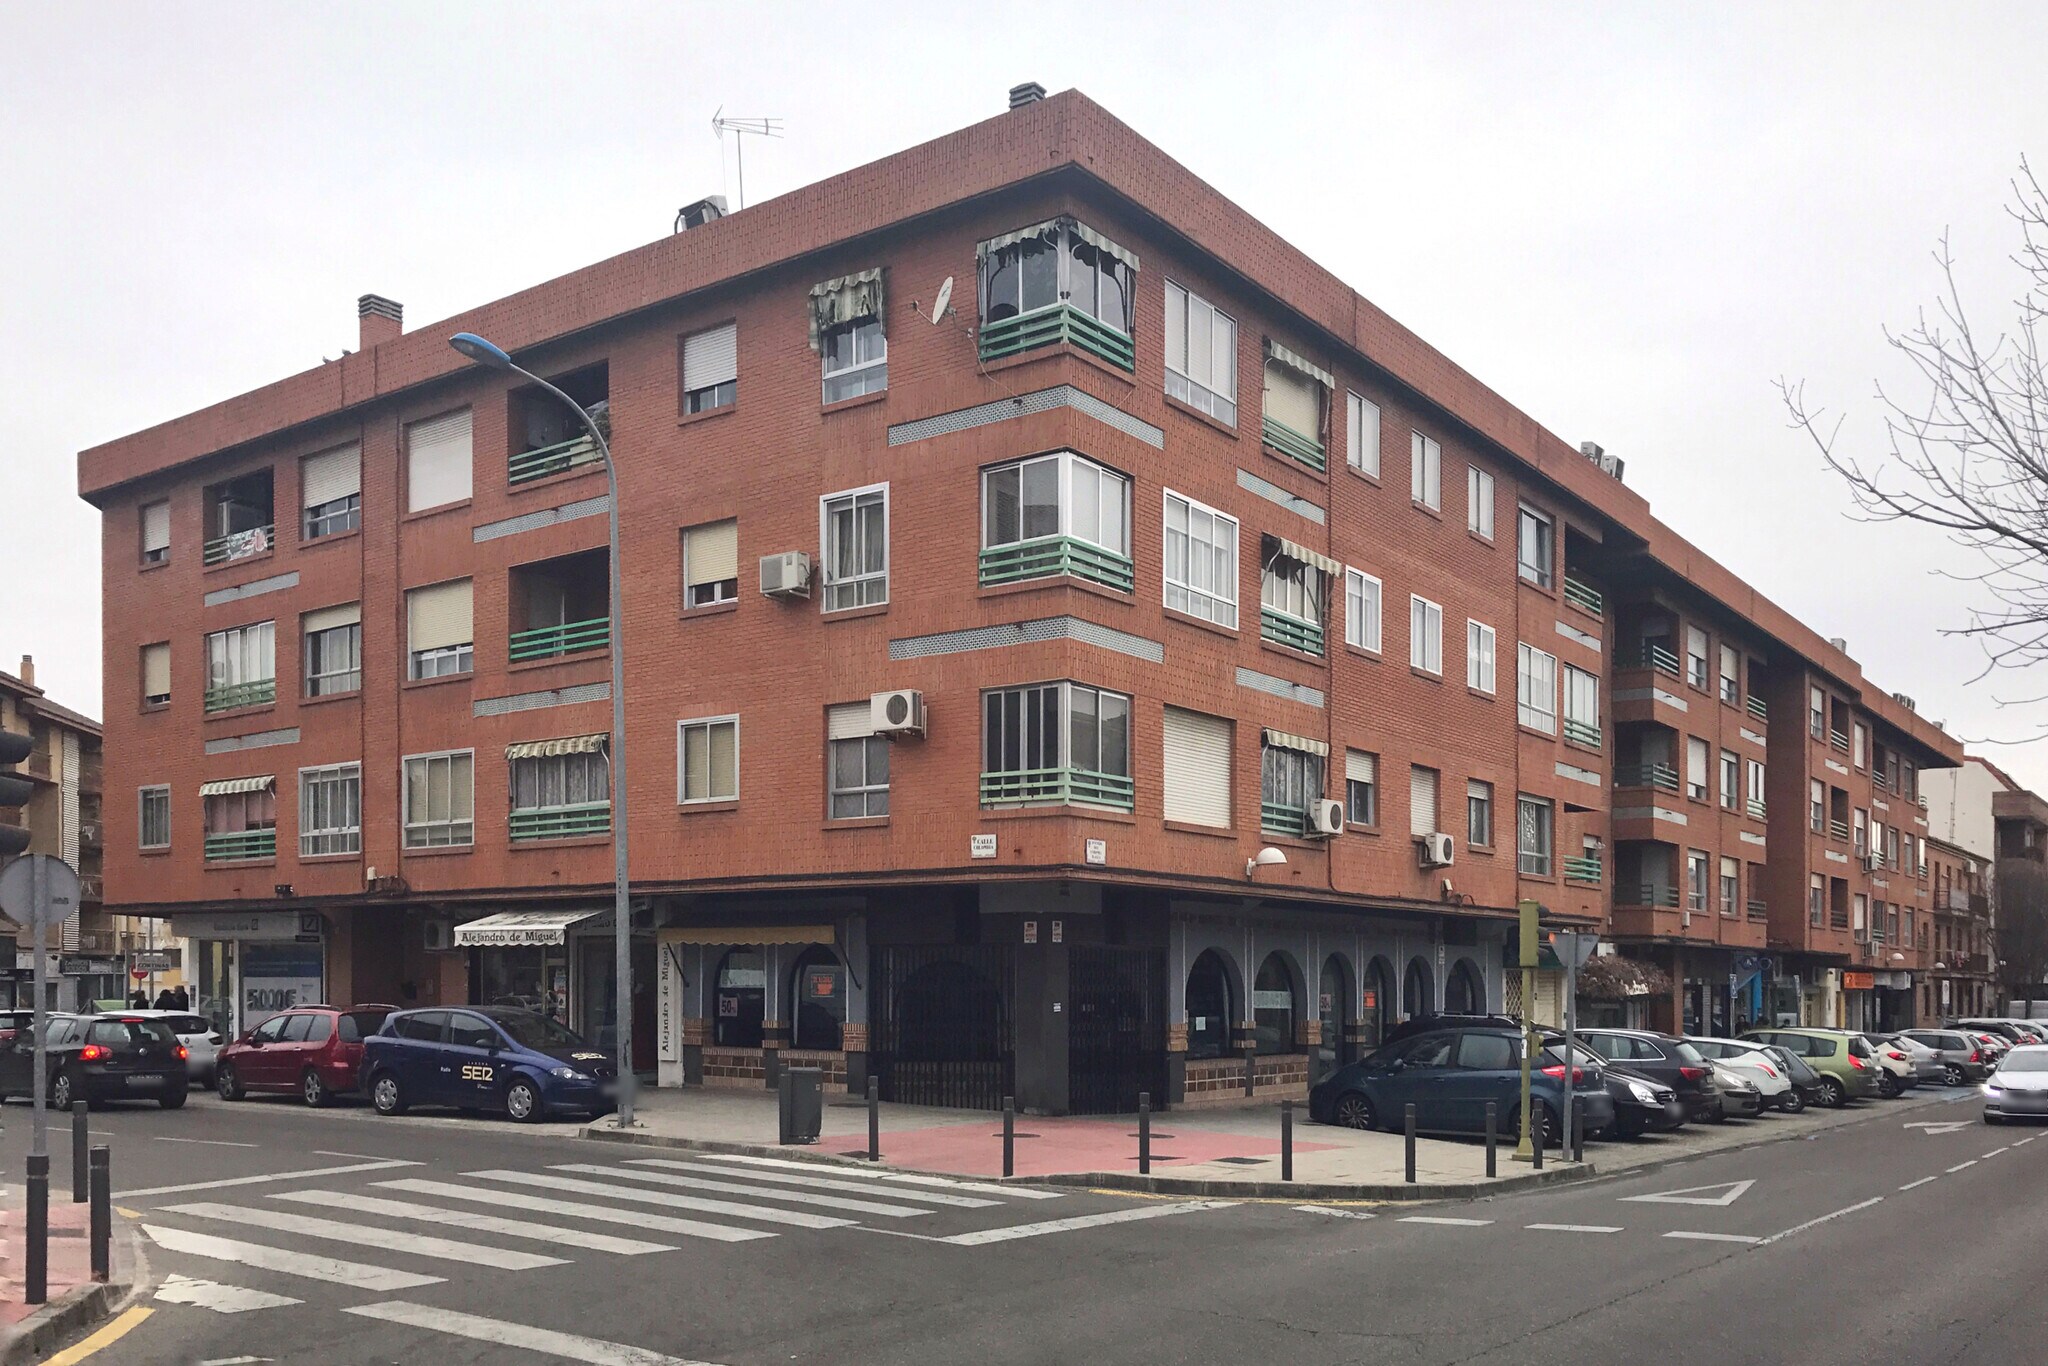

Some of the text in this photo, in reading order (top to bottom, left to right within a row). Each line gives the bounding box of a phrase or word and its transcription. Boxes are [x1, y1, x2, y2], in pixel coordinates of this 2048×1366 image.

[461, 931, 557, 943] Alejandro de Miguel
[661, 947, 670, 980] Miguel
[661, 1002, 670, 1053] Alejandro
[462, 1065, 493, 1081] SER
